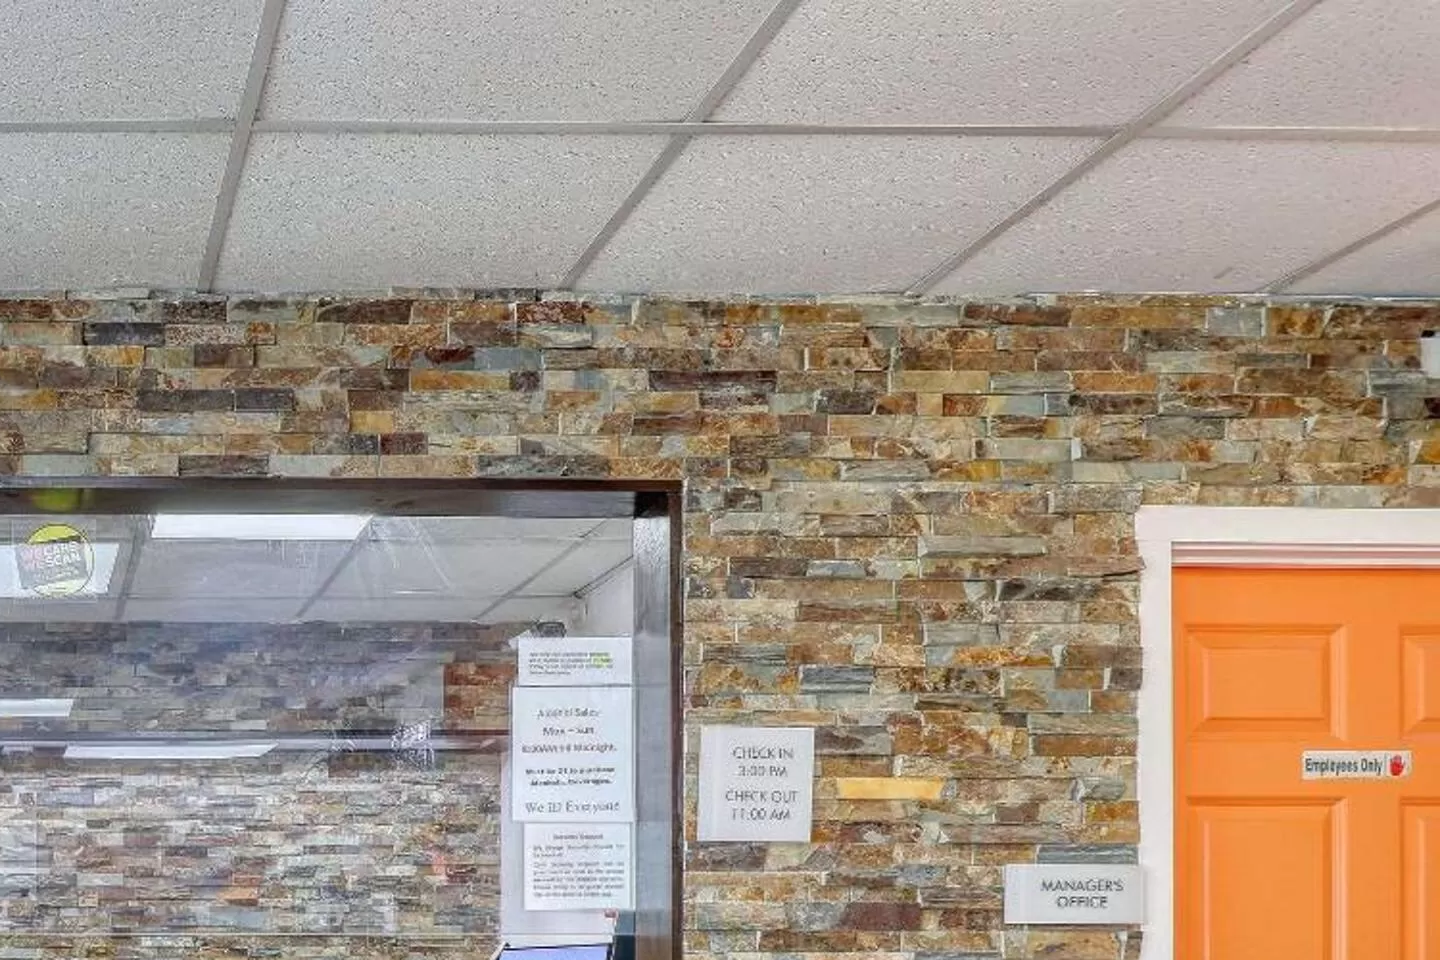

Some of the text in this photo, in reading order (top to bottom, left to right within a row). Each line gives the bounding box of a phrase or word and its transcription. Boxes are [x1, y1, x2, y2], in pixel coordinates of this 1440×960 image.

[45, 553, 81, 568] SCAN
[732, 746, 795, 760] CHECK IN
[738, 765, 789, 778] 3:00 PM
[1305, 758, 1383, 776] Employees Only
[725, 790, 799, 803] CHECK OUT
[525, 802, 545, 813] We
[548, 802, 562, 813] ID
[732, 808, 791, 821] 11:00 AM
[1040, 879, 1125, 892] MANAGER'S
[1057, 896, 1108, 909] OFFICE
